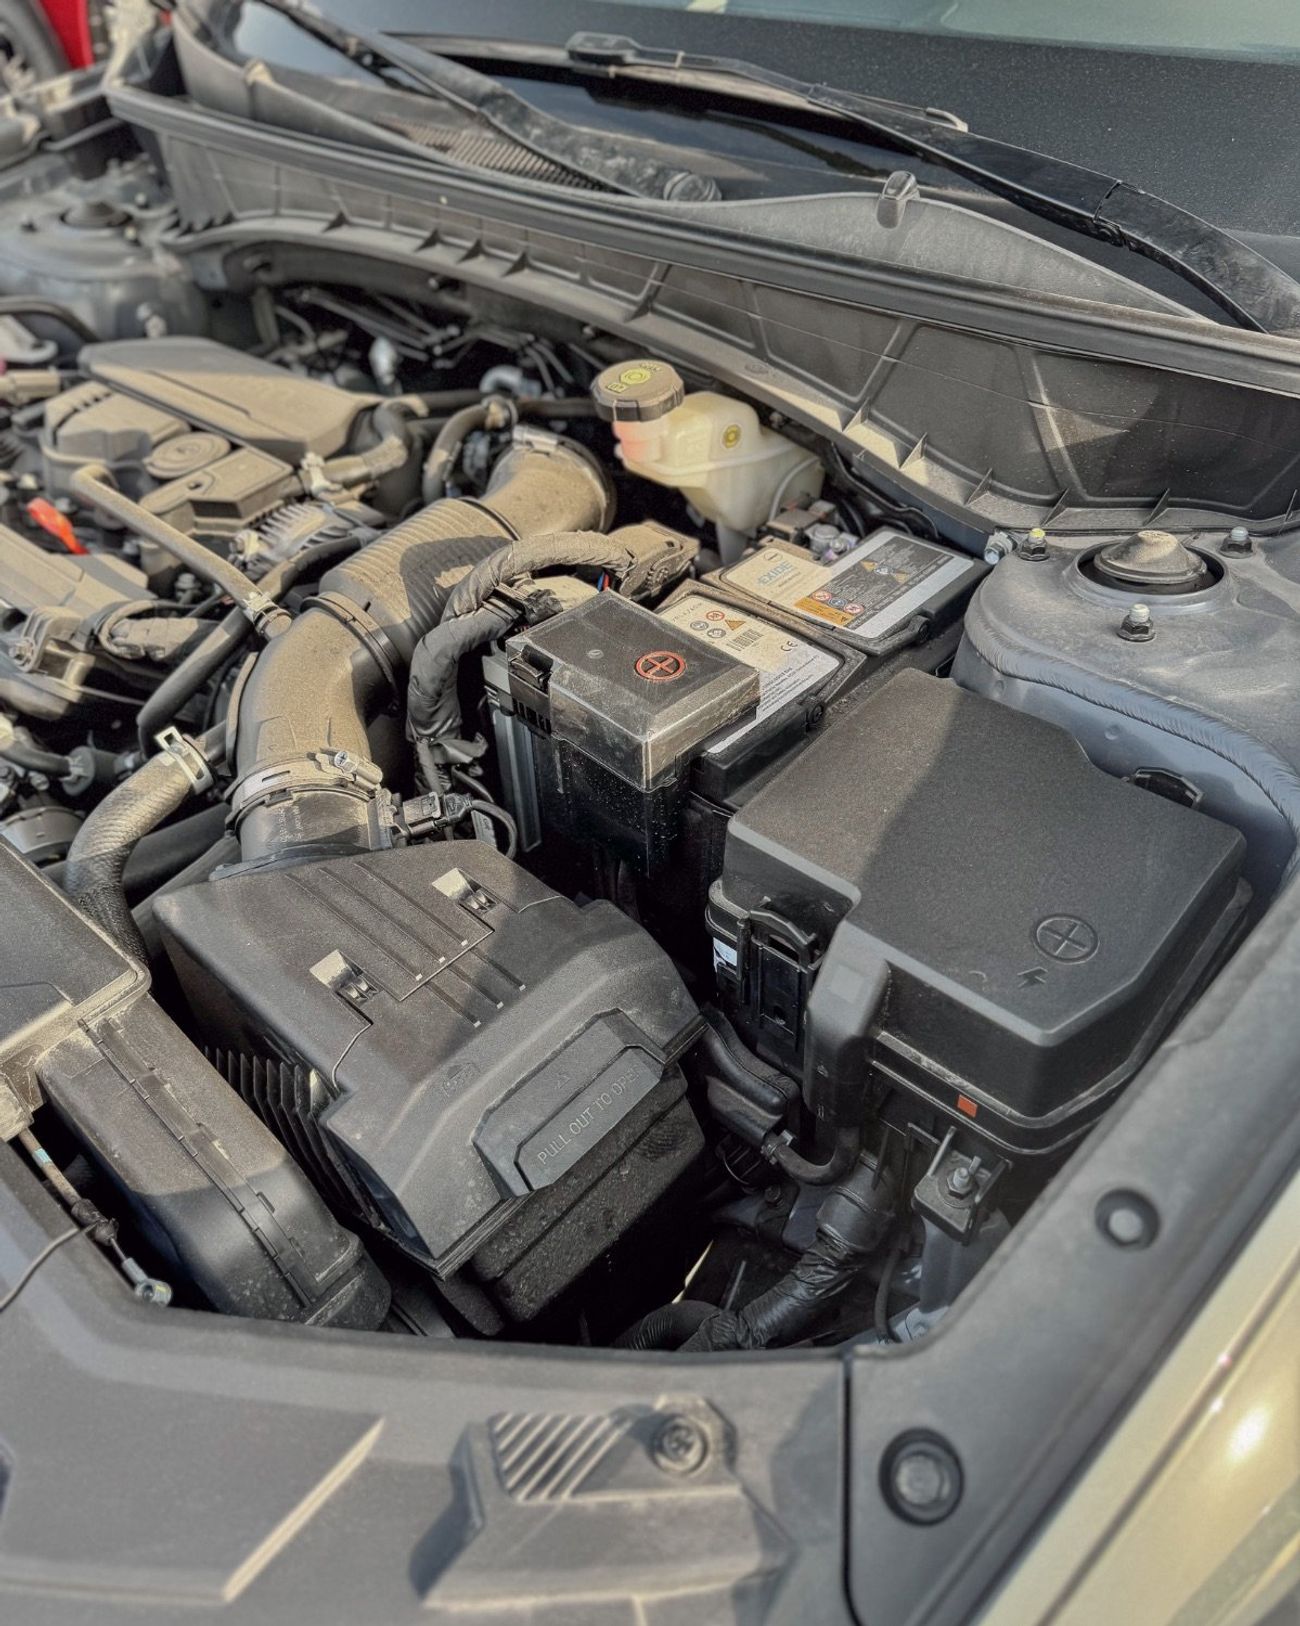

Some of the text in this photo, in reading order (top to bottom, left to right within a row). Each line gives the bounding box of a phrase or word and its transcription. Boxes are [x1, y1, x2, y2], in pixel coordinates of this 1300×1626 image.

[758, 560, 794, 585] EXIDE
[537, 1134, 572, 1164] PULL
[569, 1107, 594, 1135] OUT
[593, 1092, 612, 1110] TO
